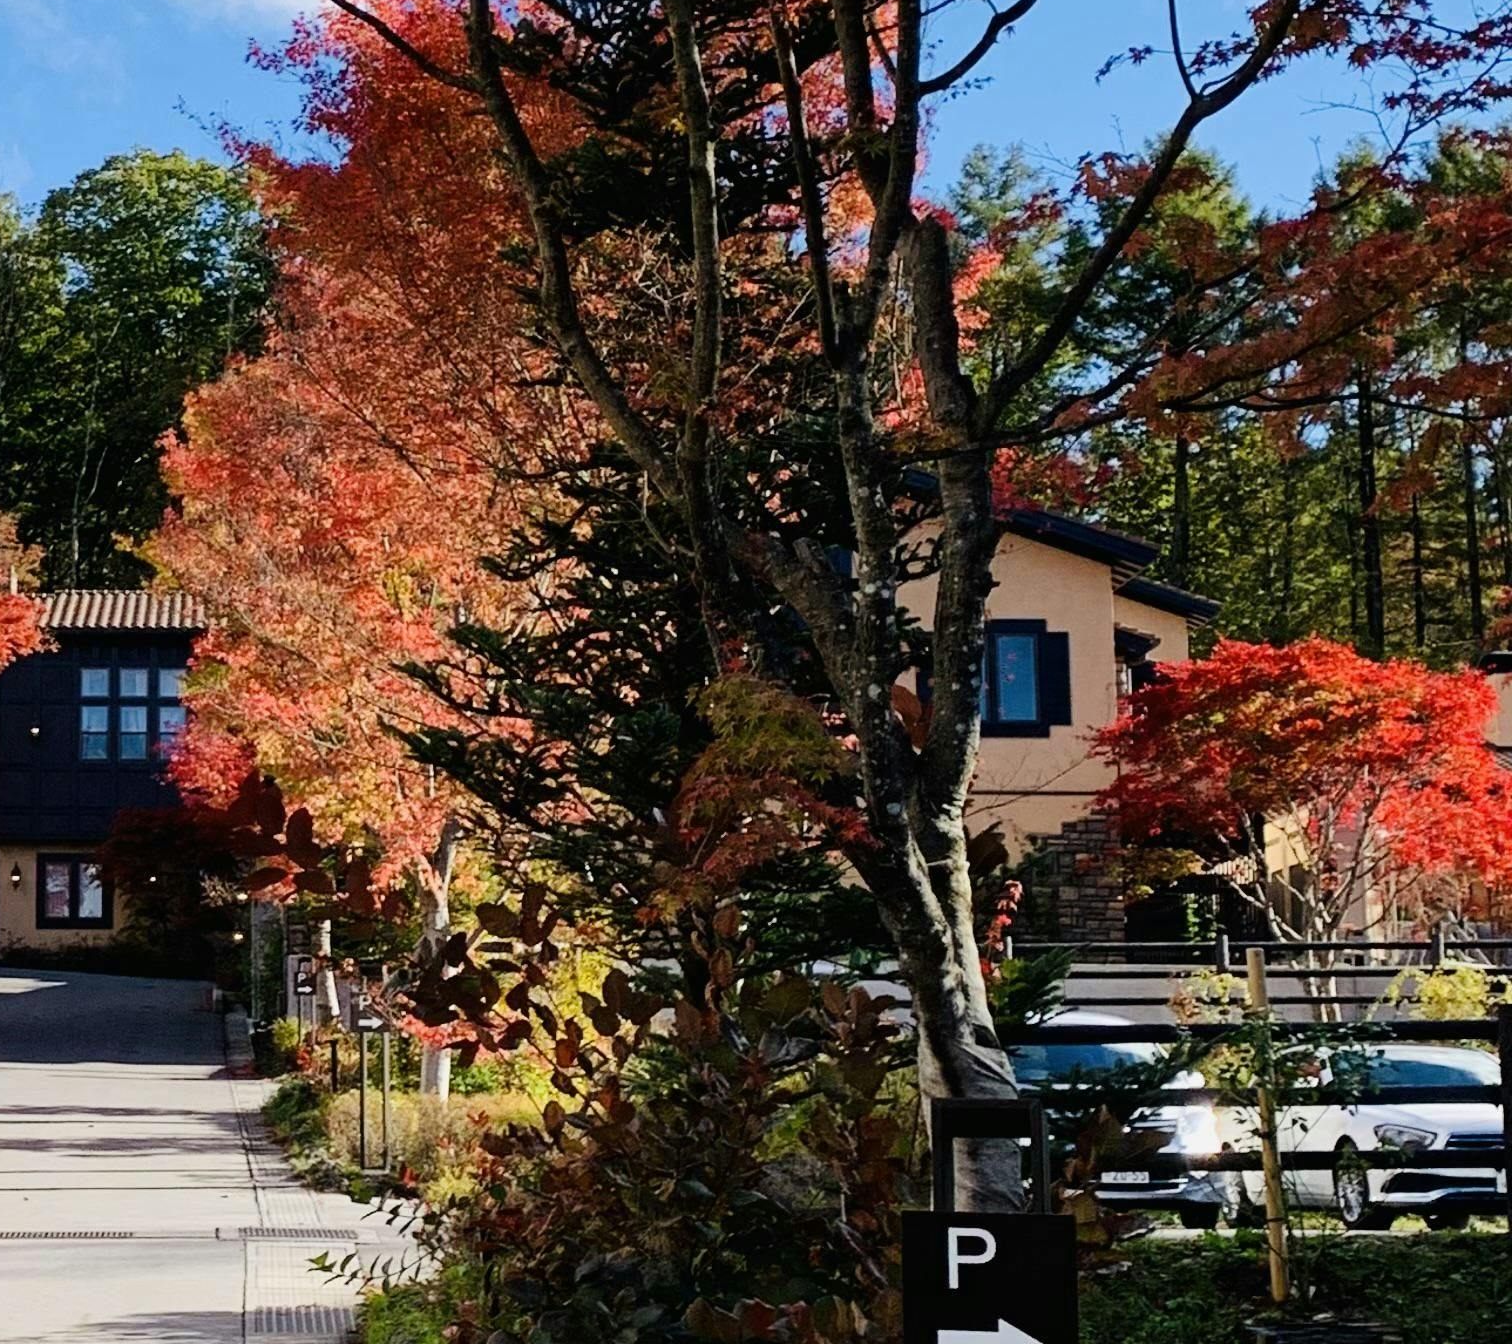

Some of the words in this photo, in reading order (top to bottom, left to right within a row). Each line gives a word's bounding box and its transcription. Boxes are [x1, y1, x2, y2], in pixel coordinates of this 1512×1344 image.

[297, 972, 307, 983] P
[359, 995, 372, 1011] P
[948, 1227, 997, 1289] P
